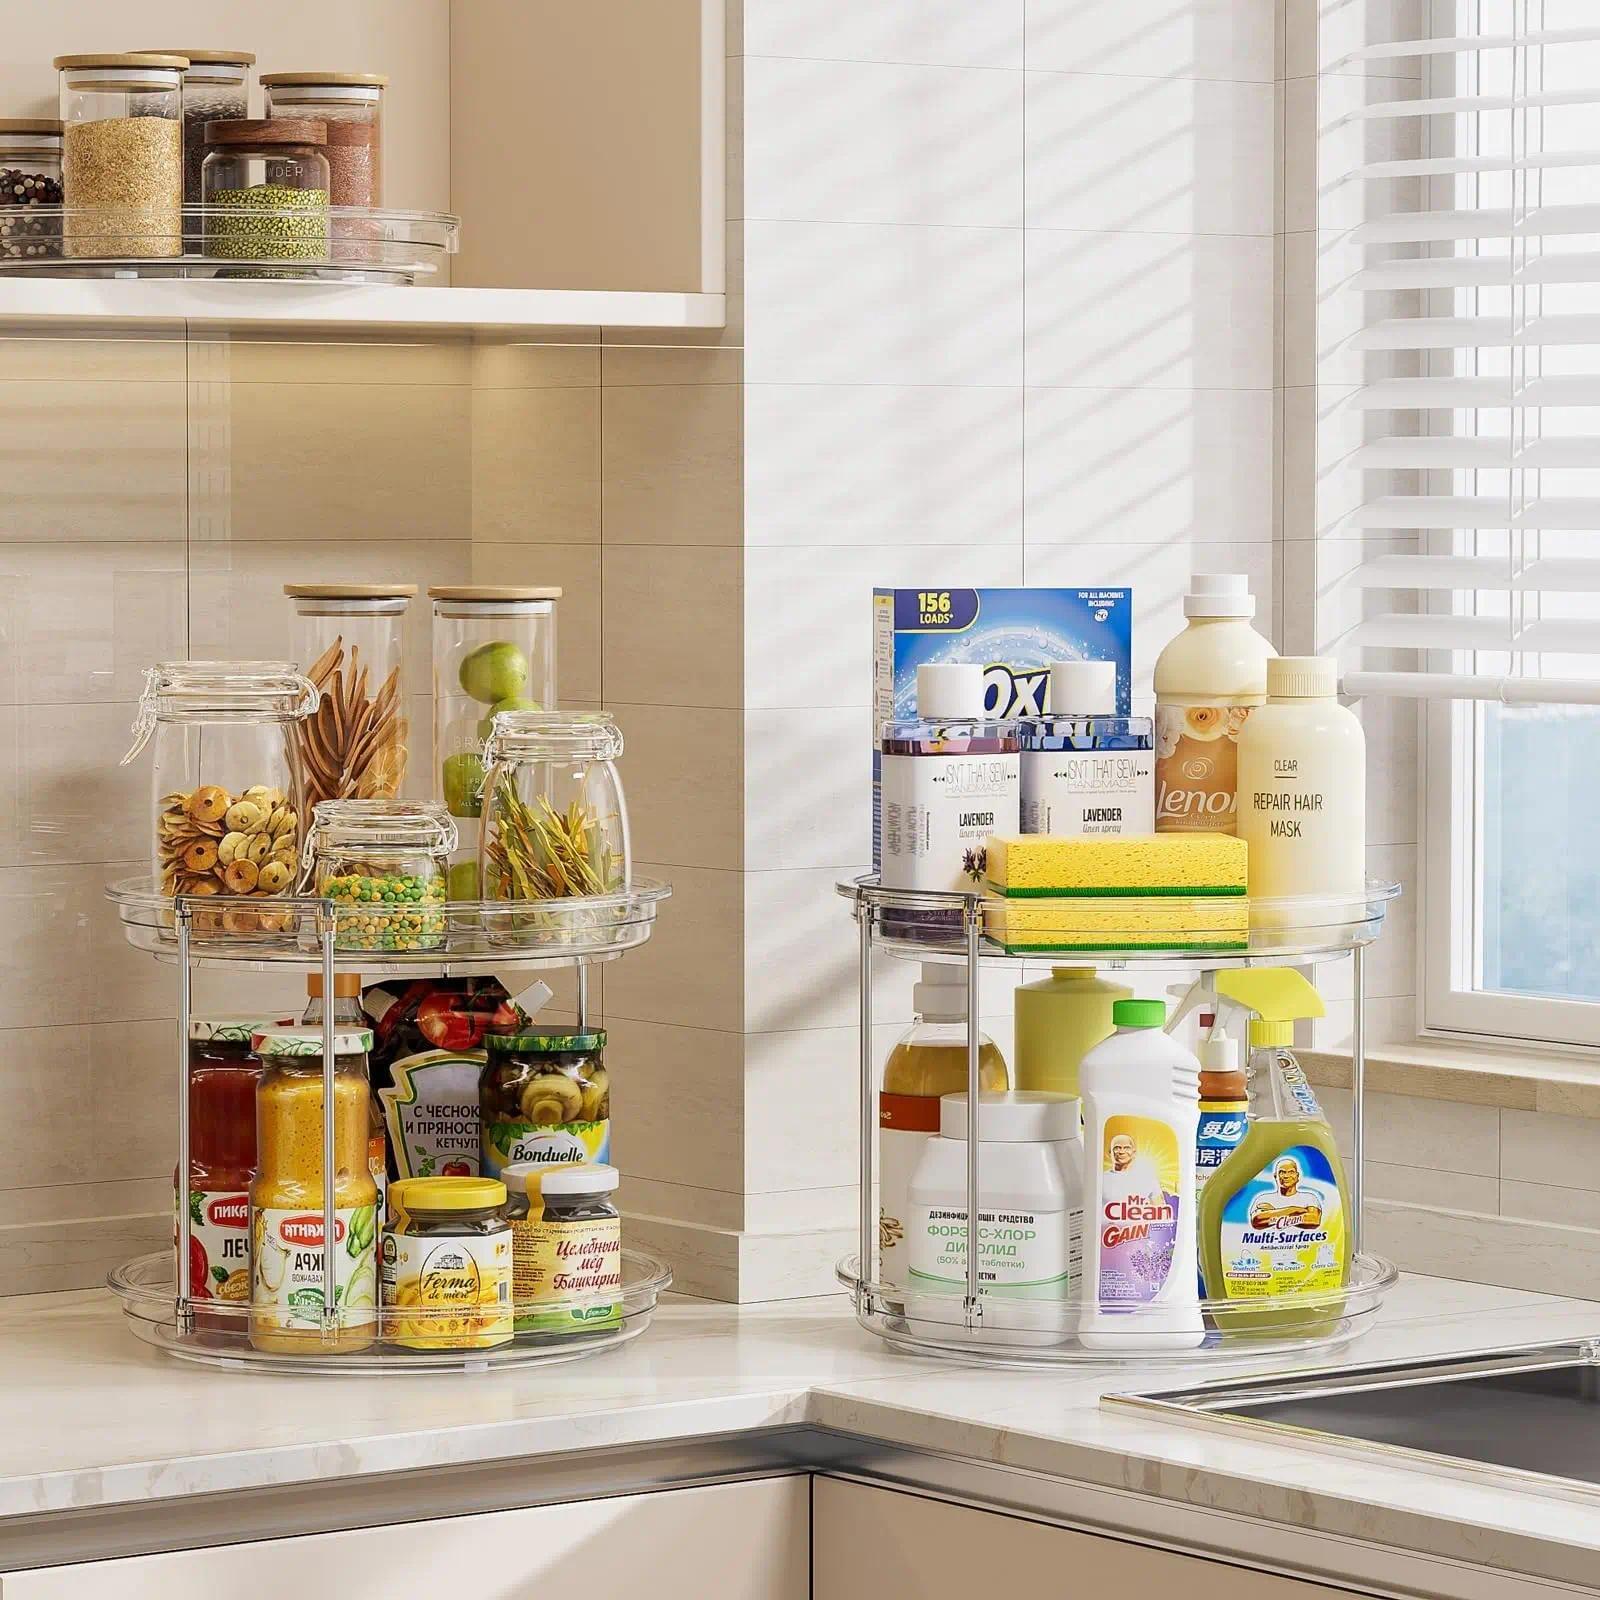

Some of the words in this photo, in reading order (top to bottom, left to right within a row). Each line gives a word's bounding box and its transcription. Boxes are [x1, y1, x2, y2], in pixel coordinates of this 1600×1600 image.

[918, 592, 951, 613] 156
[1092, 759, 1115, 779] THAT
[1117, 758, 1138, 779] SEW
[1274, 760, 1298, 771] CLEAR
[1253, 793, 1291, 810] REPAIR
[1294, 794, 1323, 811] HAIR
[959, 812, 994, 827] LAVENDER
[1083, 808, 1122, 822] LAVENDER
[1270, 820, 1302, 838] MASK
[413, 1105, 423, 1118] С
[426, 1105, 480, 1118] ЧЕСНОК
[405, 1121, 414, 1134] И
[417, 1121, 480, 1135] ПРЯНОСТ
[436, 1137, 479, 1149] КЕТЧУП
[513, 1144, 584, 1163] Bonduelle
[1127, 1195, 1149, 1206] Mr.
[214, 1205, 248, 1220] ПИКА
[1104, 1201, 1172, 1221] Clean
[998, 1214, 1034, 1224] СРЕДСТВО
[927, 1224, 1037, 1241] ФОРЭС-ХЛОР
[1102, 1224, 1150, 1248] GAIN
[1241, 1230, 1328, 1244] Multi-Surfaces
[945, 1241, 1017, 1256] ДИОЛИД
[423, 1271, 476, 1289] Ferma
